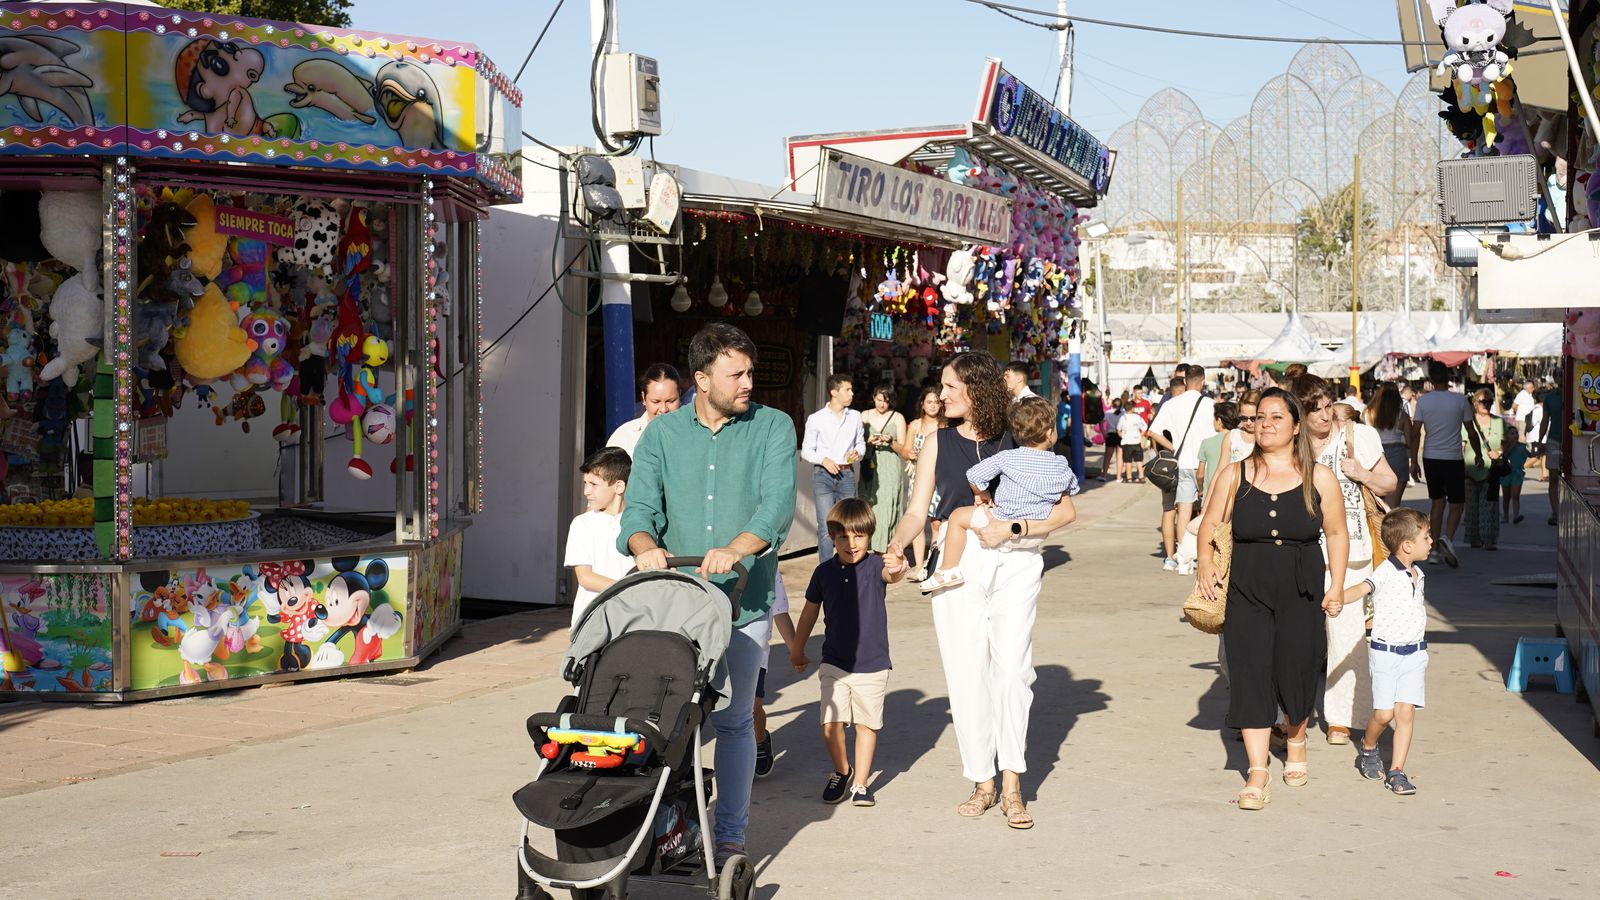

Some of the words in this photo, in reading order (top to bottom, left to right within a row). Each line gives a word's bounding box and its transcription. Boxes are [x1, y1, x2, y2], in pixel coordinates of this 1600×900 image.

[837, 161, 886, 207] TIRO
[890, 176, 924, 216] LOS
[931, 188, 1005, 235] BARRILES
[219, 212, 265, 233] SIEMPRE
[267, 221, 294, 239] TOCA
